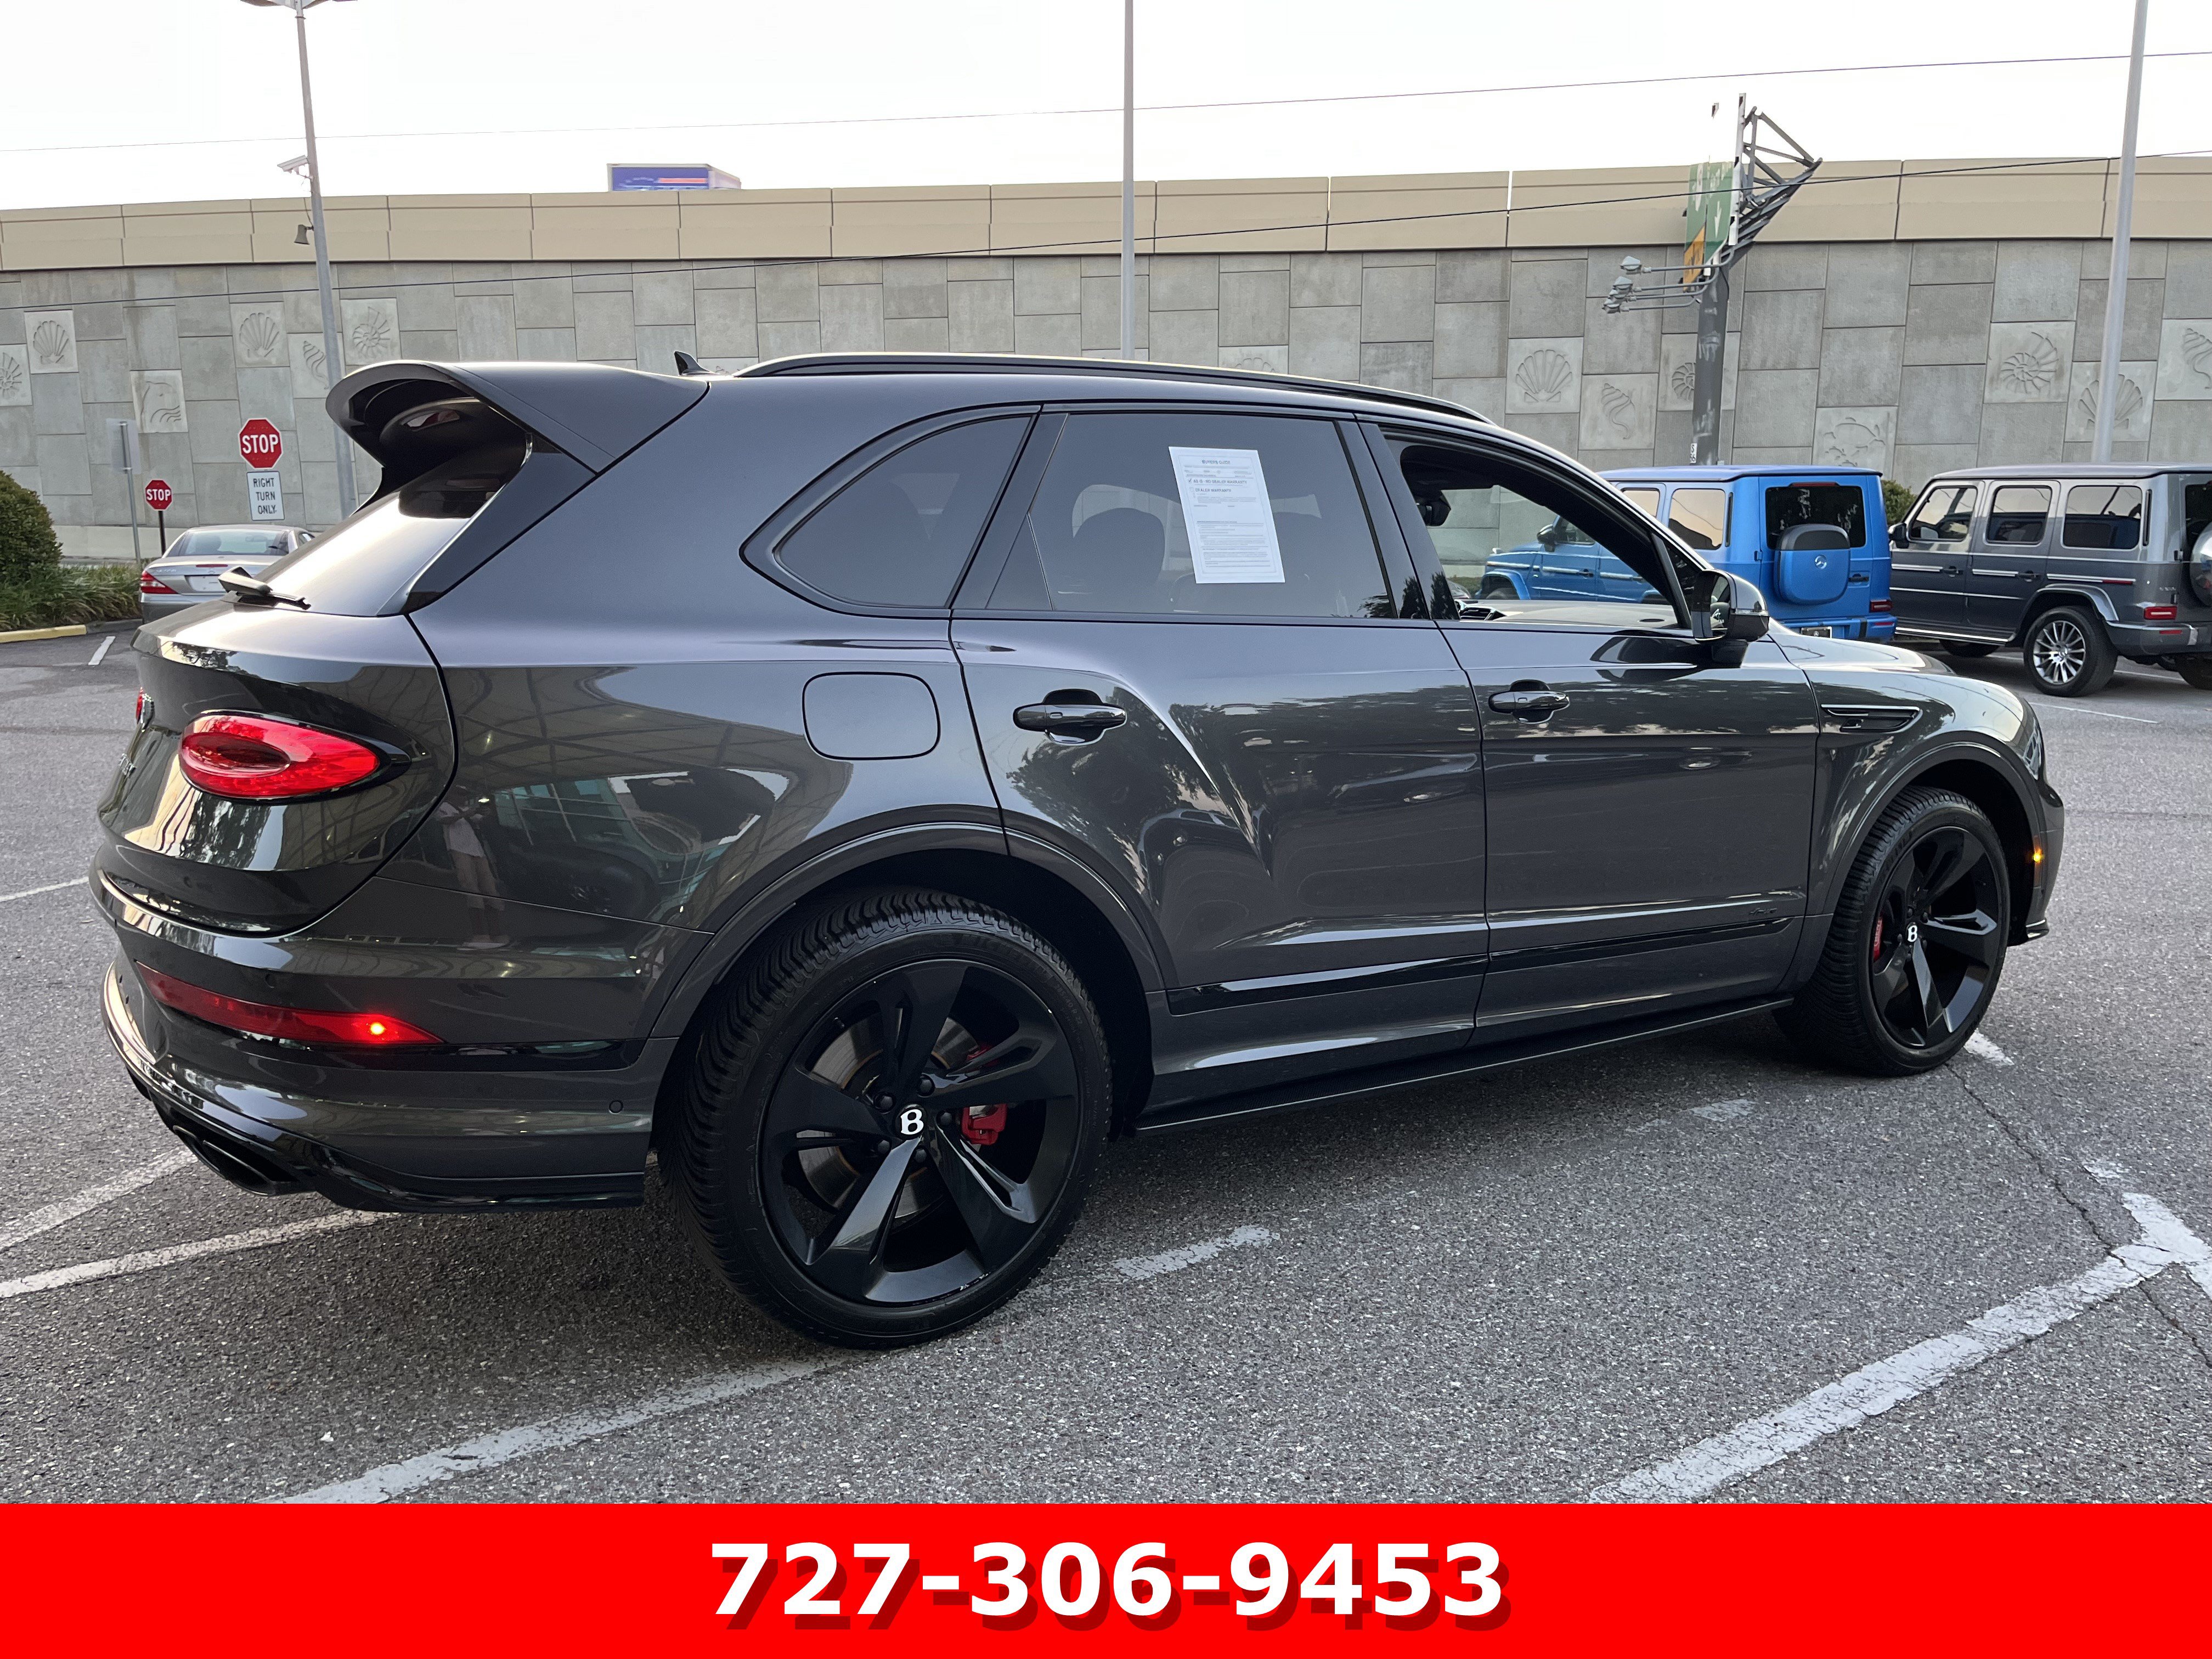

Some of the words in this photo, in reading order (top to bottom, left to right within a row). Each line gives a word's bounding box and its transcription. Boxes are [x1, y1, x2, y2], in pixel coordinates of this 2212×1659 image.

[242, 434, 279, 454] STOP
[253, 478, 274, 488] RIGHT
[146, 489, 171, 501] STOP
[256, 492, 275, 500] TURN
[257, 505, 277, 515] ONLY
[1908, 925, 1918, 942] B
[900, 1109, 924, 1135] B
